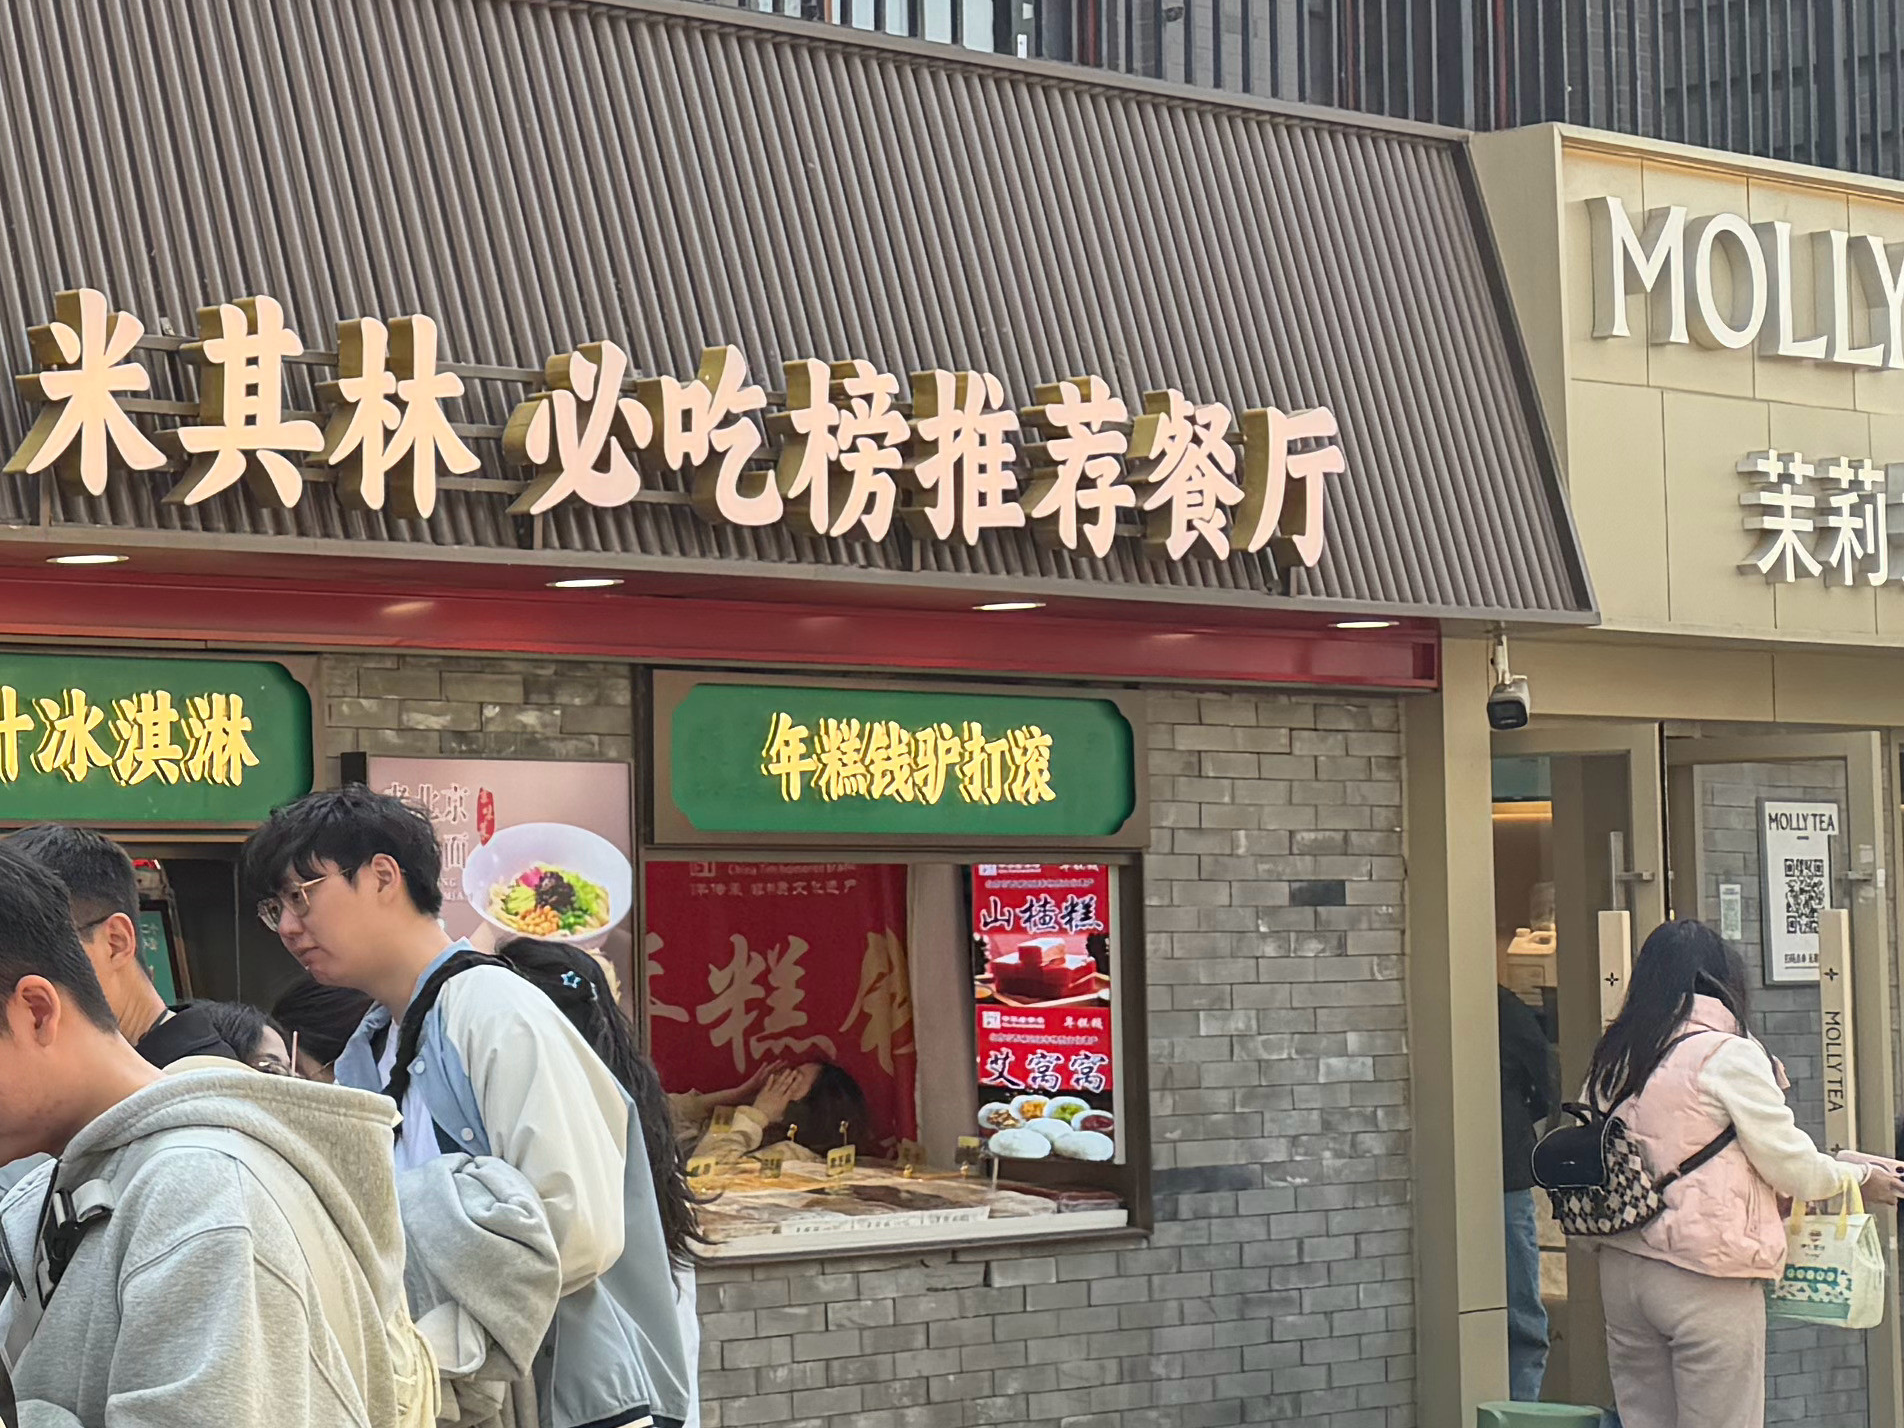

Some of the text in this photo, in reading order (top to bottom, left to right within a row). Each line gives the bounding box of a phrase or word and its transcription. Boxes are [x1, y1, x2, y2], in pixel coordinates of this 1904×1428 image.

[17, 287, 1346, 568] 米其林 必吃榜推荐餐厅
[1742, 448, 1904, 587] 茉莉
[762, 711, 1056, 805] 年糕钱驴打滚
[1768, 812, 1836, 832] MOLLY TEA
[980, 894, 1104, 935] 山楂糕
[980, 1047, 1109, 1093] 艾窝窝
[1824, 1011, 1845, 1113] MOLLY TEA
